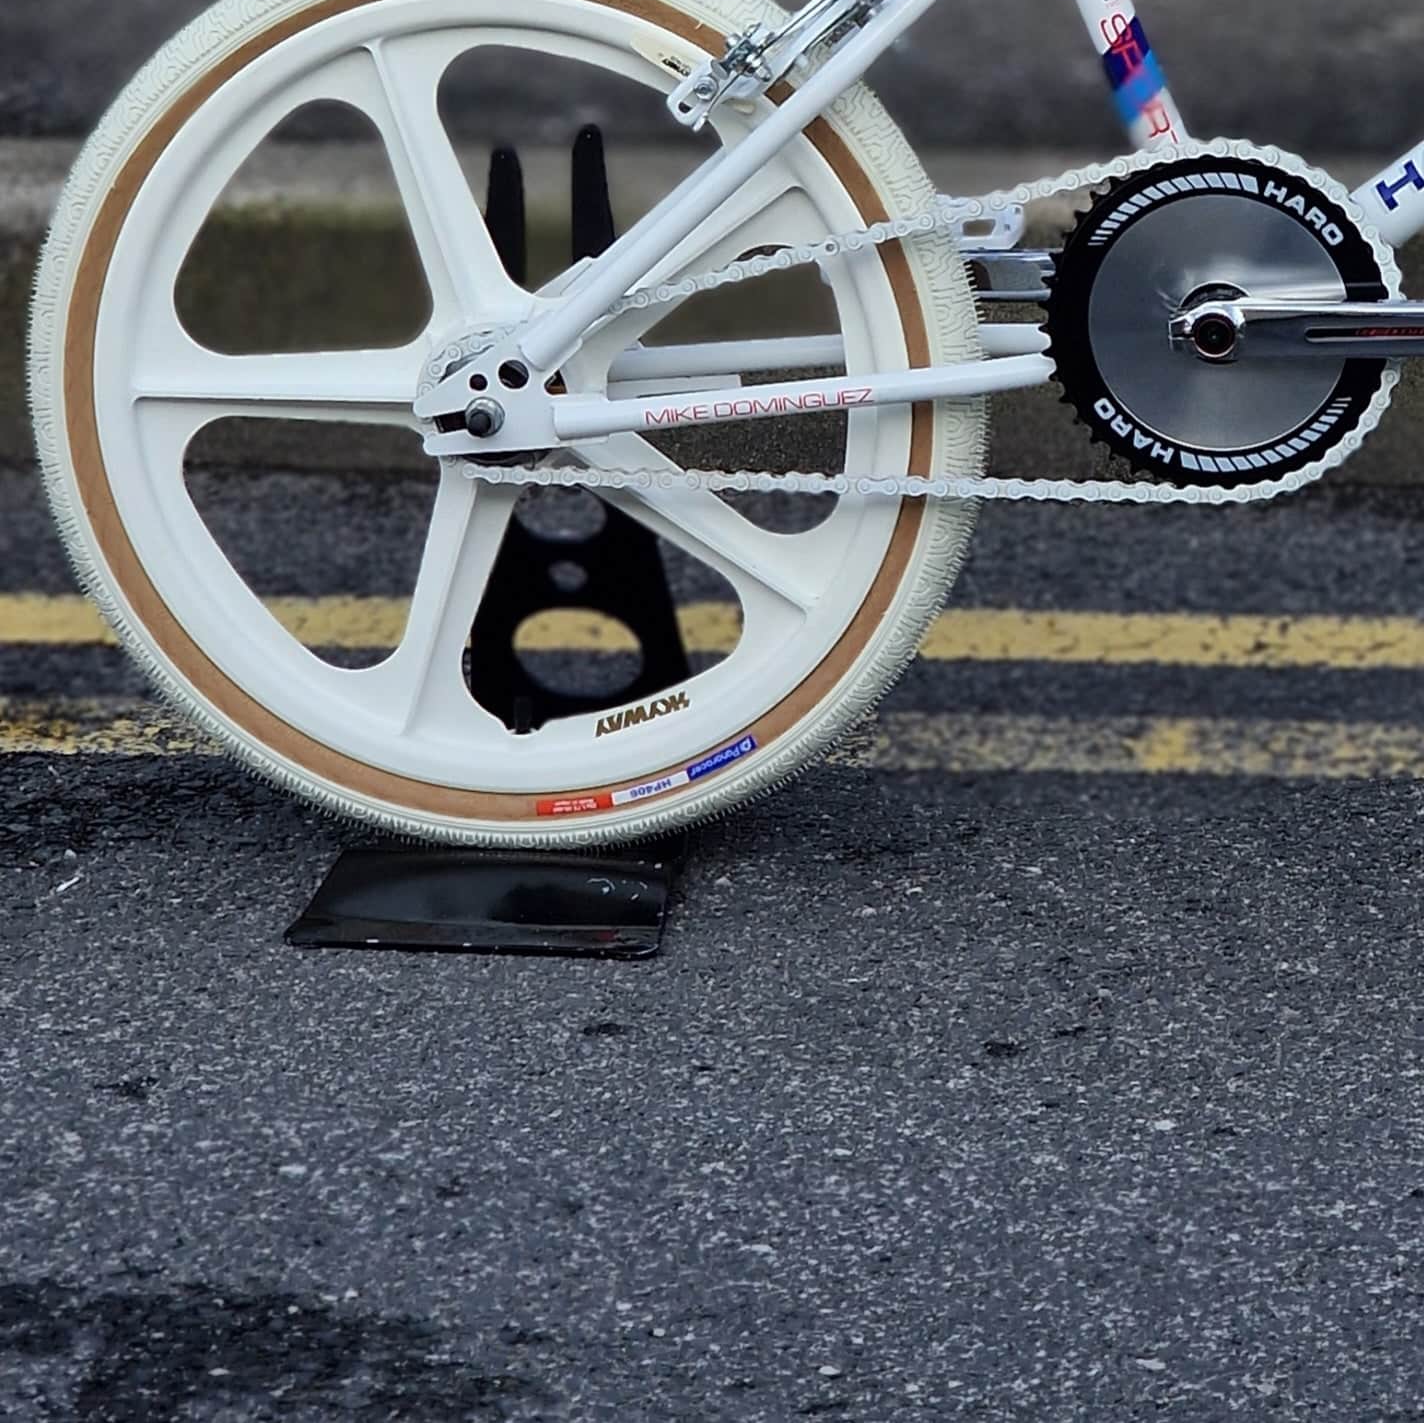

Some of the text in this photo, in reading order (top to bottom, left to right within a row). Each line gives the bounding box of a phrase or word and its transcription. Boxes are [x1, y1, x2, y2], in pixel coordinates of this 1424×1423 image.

[1263, 180, 1344, 247] HARO
[645, 388, 876, 425] MIKE DOMINGUEZ
[1093, 397, 1175, 465] HARO
[594, 691, 691, 738] SKYWAY
[629, 743, 741, 799] Panaracer HP406
